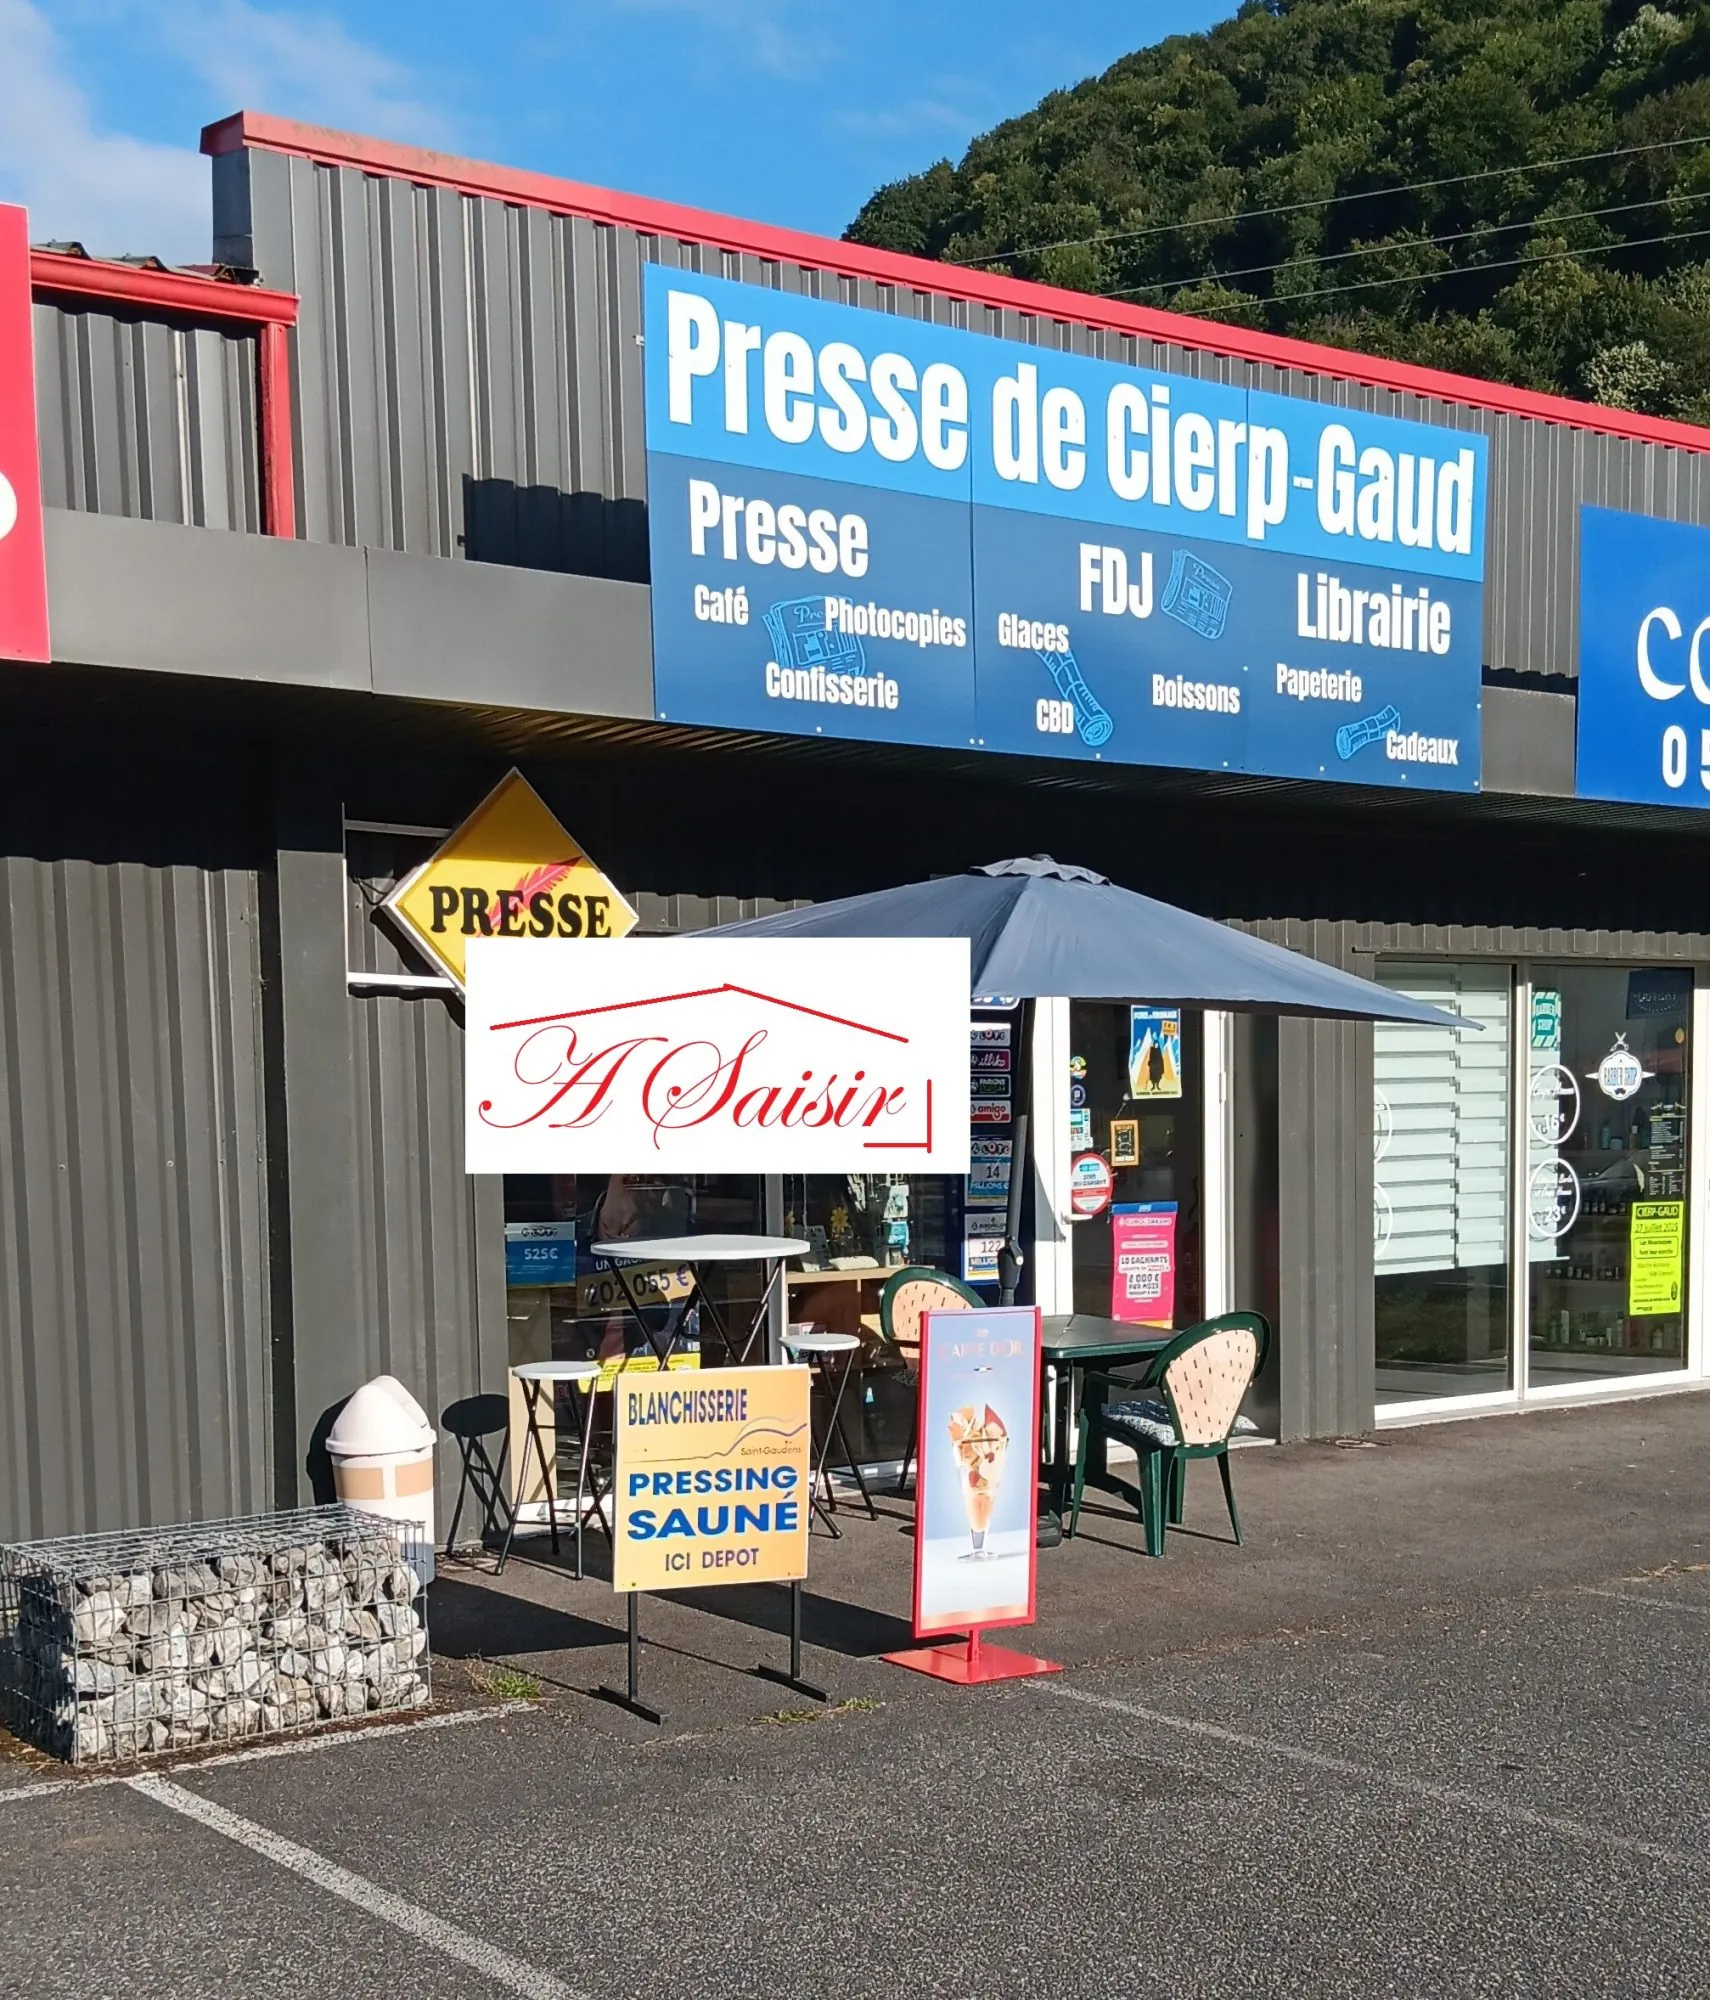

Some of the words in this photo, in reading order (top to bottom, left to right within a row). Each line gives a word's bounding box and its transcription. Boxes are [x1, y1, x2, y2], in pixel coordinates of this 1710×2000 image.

[668, 290, 968, 470] Presse
[993, 362, 1086, 491] de
[1106, 383, 1475, 555] Cierp-Gaud
[689, 479, 869, 577] Presse
[1079, 543, 1153, 619] FDJ
[694, 584, 748, 625] Café
[824, 596, 967, 648] Photocopies
[1297, 573, 1451, 655] Librairie
[998, 613, 1069, 654] Glaces
[766, 662, 898, 709] Confisserie
[1152, 674, 1240, 715] Boissons
[1276, 663, 1362, 703] Papeterie
[1036, 699, 1074, 734] CBD
[1386, 730, 1459, 766] Cadeaux
[429, 886, 612, 938] PRESSE
[978, 1103, 1006, 1120] amigo
[986, 1165, 1000, 1178] 14
[524, 1247, 558, 1260] 525€
[981, 1240, 1001, 1253] 122
[676, 1263, 690, 1287] €
[628, 1388, 747, 1425] BLANCHISSERIE
[741, 1445, 802, 1456] Saint-Gaudens
[629, 1466, 798, 1496] PRESSING
[627, 1491, 798, 1540] SAUNÉ
[665, 1553, 690, 1571] ICI
[702, 1548, 759, 1568] DEPOT
